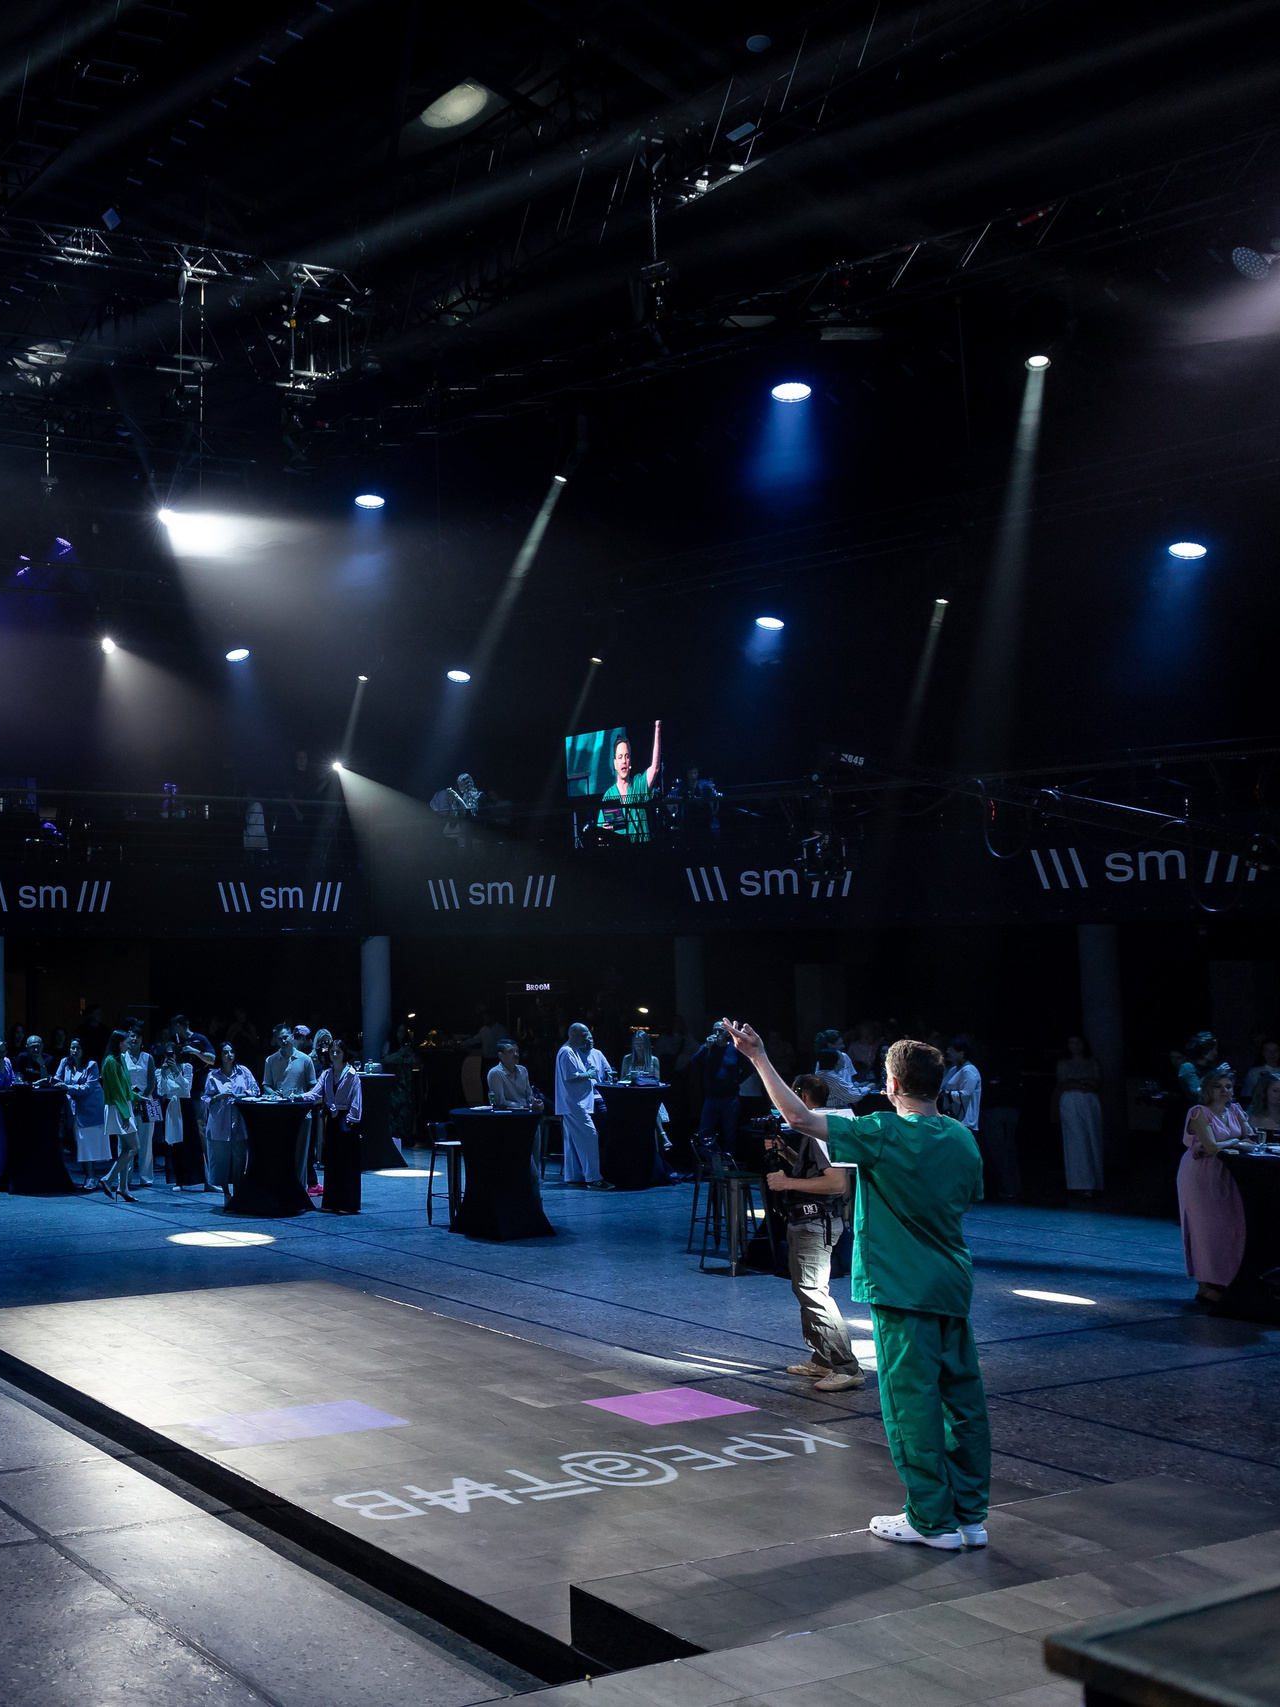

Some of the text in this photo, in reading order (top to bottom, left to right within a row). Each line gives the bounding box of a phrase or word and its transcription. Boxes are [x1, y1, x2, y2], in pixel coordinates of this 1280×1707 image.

[1105, 849, 1187, 883] sm
[468, 881, 514, 906] sm
[740, 868, 798, 897] sm
[19, 885, 67, 909] sm
[260, 886, 304, 910] sm
[525, 983, 551, 991] BROOM
